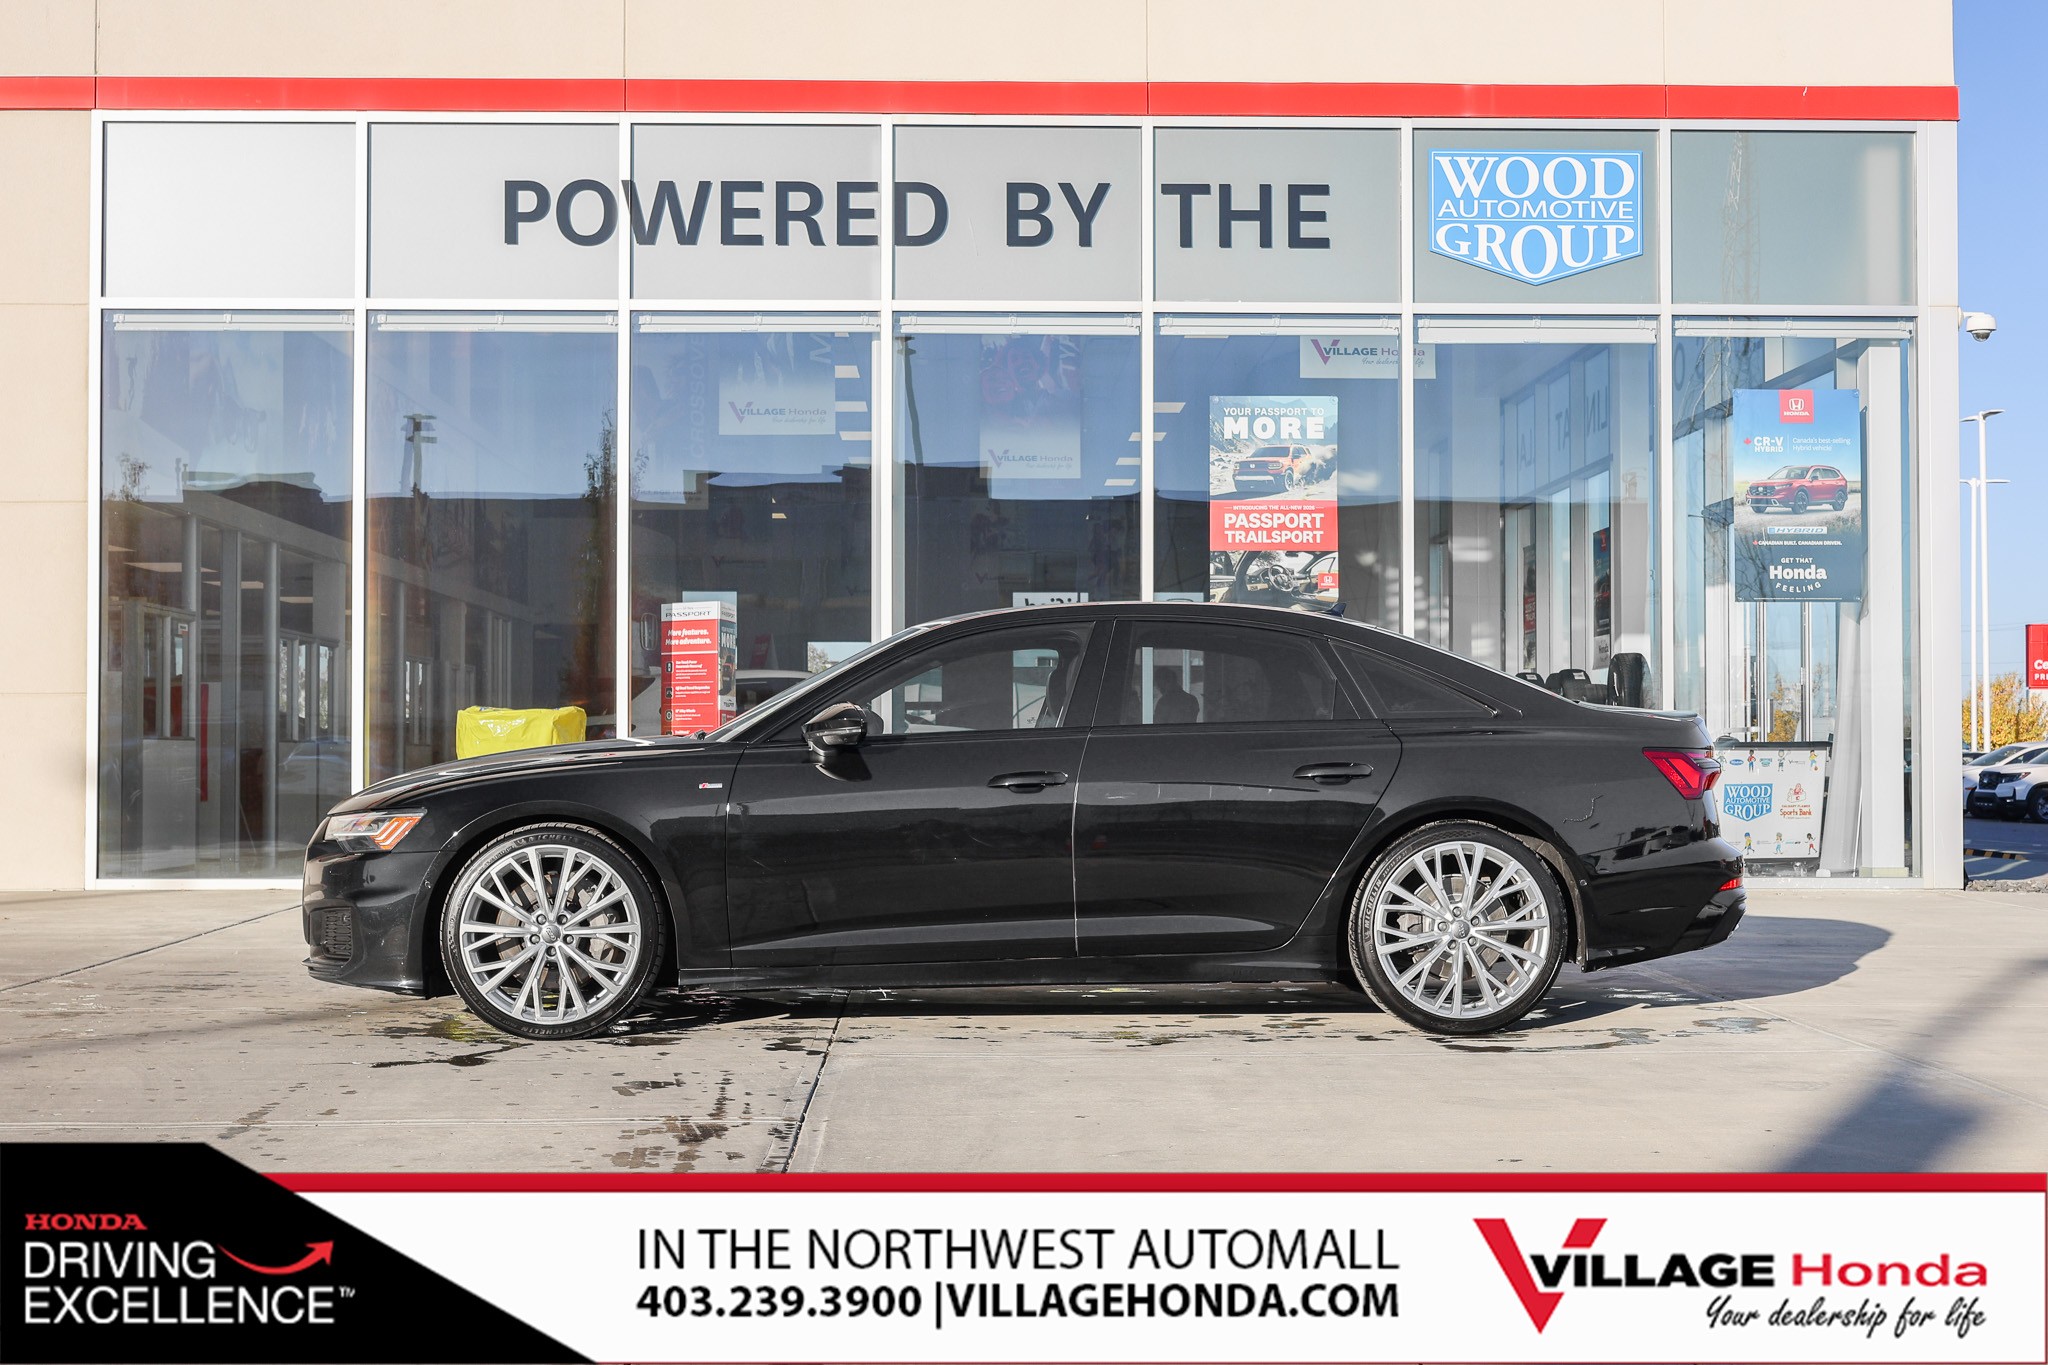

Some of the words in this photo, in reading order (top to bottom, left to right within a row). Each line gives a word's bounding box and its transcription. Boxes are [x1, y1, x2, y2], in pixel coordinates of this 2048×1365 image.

[1435, 156, 1635, 199] WOOD
[504, 178, 950, 248] POWERED
[1004, 181, 1111, 248] BY
[1160, 183, 1332, 250] THE
[1438, 200, 1634, 219] AUTOMOTIVE
[1435, 223, 1635, 279] GROUP
[1322, 347, 1378, 356] VILLAGE
[739, 408, 786, 416] VILLAGE
[788, 408, 827, 416] Honda
[1223, 407, 1251, 416] YOUR
[1254, 407, 1307, 416] PASSPORT
[1311, 407, 1325, 416] TO
[1223, 416, 1325, 440] MORE
[1753, 436, 1784, 446] CR-V
[1818, 437, 1851, 446] best-selling
[1224, 512, 1325, 529] PASSPORT
[1224, 530, 1324, 544] TRAILSPORT
[1769, 564, 1828, 580] Honda
[1775, 581, 1822, 593] FEELING
[665, 610, 712, 618] PASSPORT
[668, 629, 681, 637] More
[681, 628, 709, 637] features.
[665, 638, 679, 646] More
[1726, 785, 1771, 798] WOOD
[1725, 803, 1771, 821] GROUP
[1779, 808, 1798, 819] Sports
[1364, 879, 1382, 929] MICHELIN
